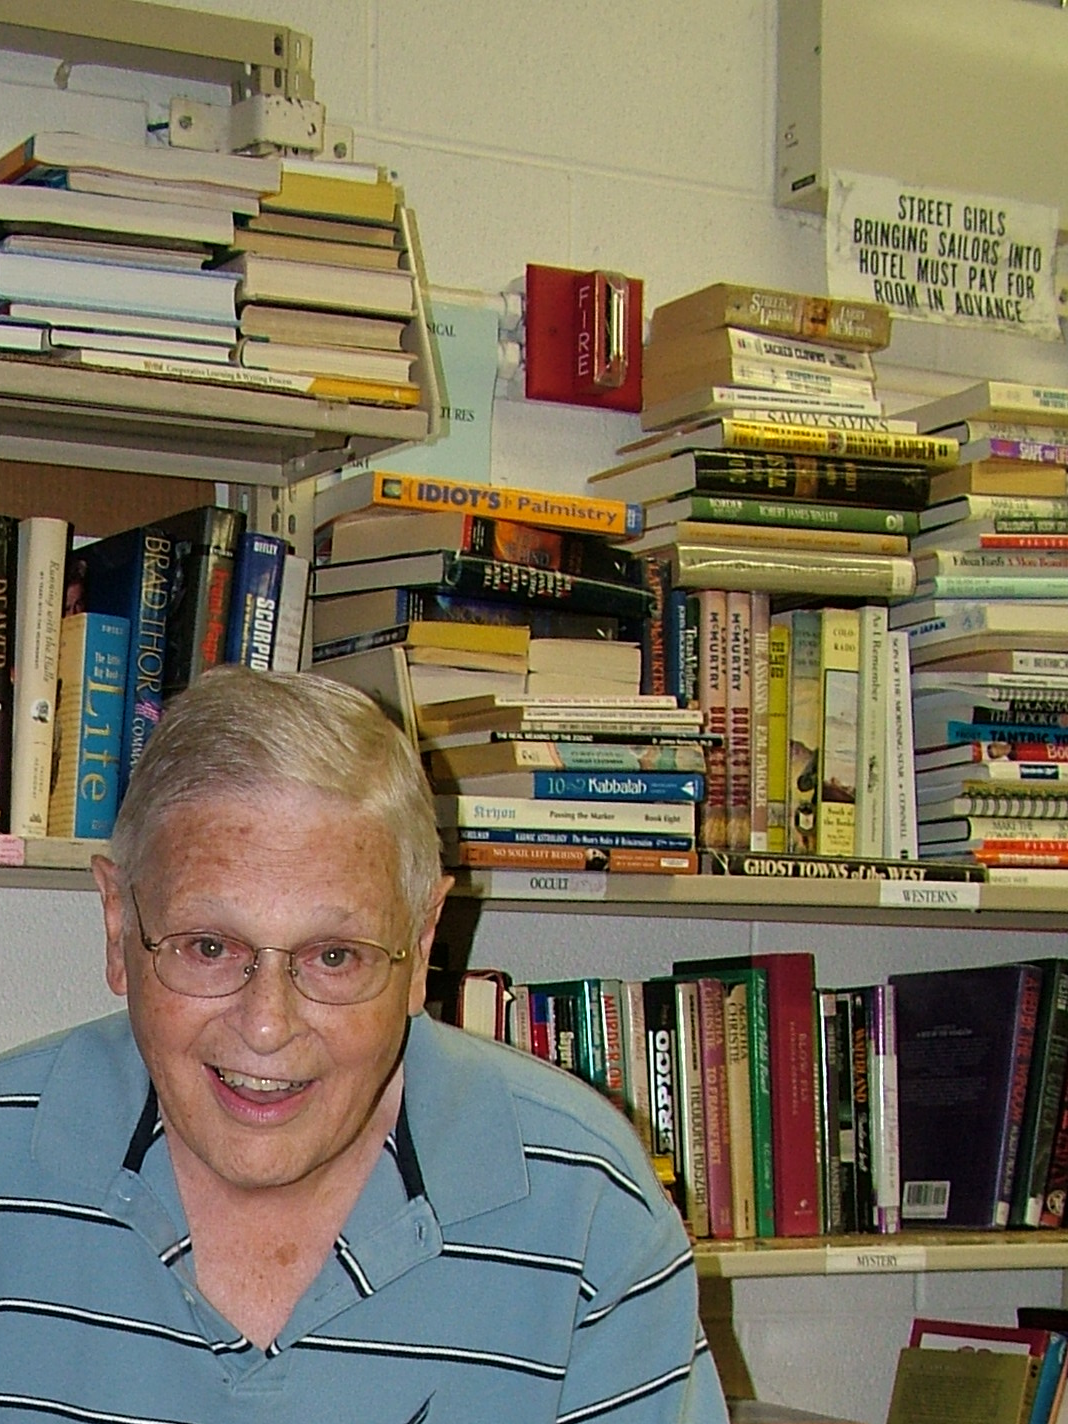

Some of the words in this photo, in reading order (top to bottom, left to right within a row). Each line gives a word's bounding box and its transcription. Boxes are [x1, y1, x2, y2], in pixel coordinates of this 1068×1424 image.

[898, 194, 953, 228] STREET
[963, 206, 1006, 236] GIRLS
[854, 218, 928, 254] BRINGING
[938, 231, 1000, 266] SAILORS
[1008, 244, 1041, 273] INTO
[859, 250, 906, 281] HOTEL
[917, 258, 958, 288] MUST
[969, 266, 997, 293] PAY
[1007, 273, 1035, 299] FOR
[874, 279, 918, 309] ROOM
[928, 288, 945, 311] IN
[955, 292, 1022, 324] ADVANCE
[578, 286, 590, 377] FIRE
[417, 483, 501, 509] IDIOT'S
[518, 497, 617, 525] Palmistry
[141, 536, 171, 610] BRAD
[872, 614, 881, 628] As
[136, 611, 167, 693] THOR
[709, 611, 719, 691] McMURTRY
[730, 612, 741, 691] McMURTRY
[870, 640, 881, 702] Remember
[496, 732, 508, 740] THE
[509, 733, 523, 741] REAL
[550, 734, 558, 742] OF
[588, 776, 647, 795] Kabbalah
[756, 753, 768, 808] PARKER
[549, 809, 575, 821] Passing
[577, 811, 589, 819] the
[591, 811, 615, 821] Marker
[644, 813, 661, 823] Book
[493, 848, 506, 857] NO
[508, 849, 528, 858] SOUL
[743, 859, 794, 876] GHOST
[797, 861, 849, 878] TOWNS
[530, 877, 569, 890] OCCULT
[902, 889, 958, 904] WESTERNS
[728, 1003, 739, 1064] CHRISTIE
[857, 1256, 898, 1268] MYSTERY
